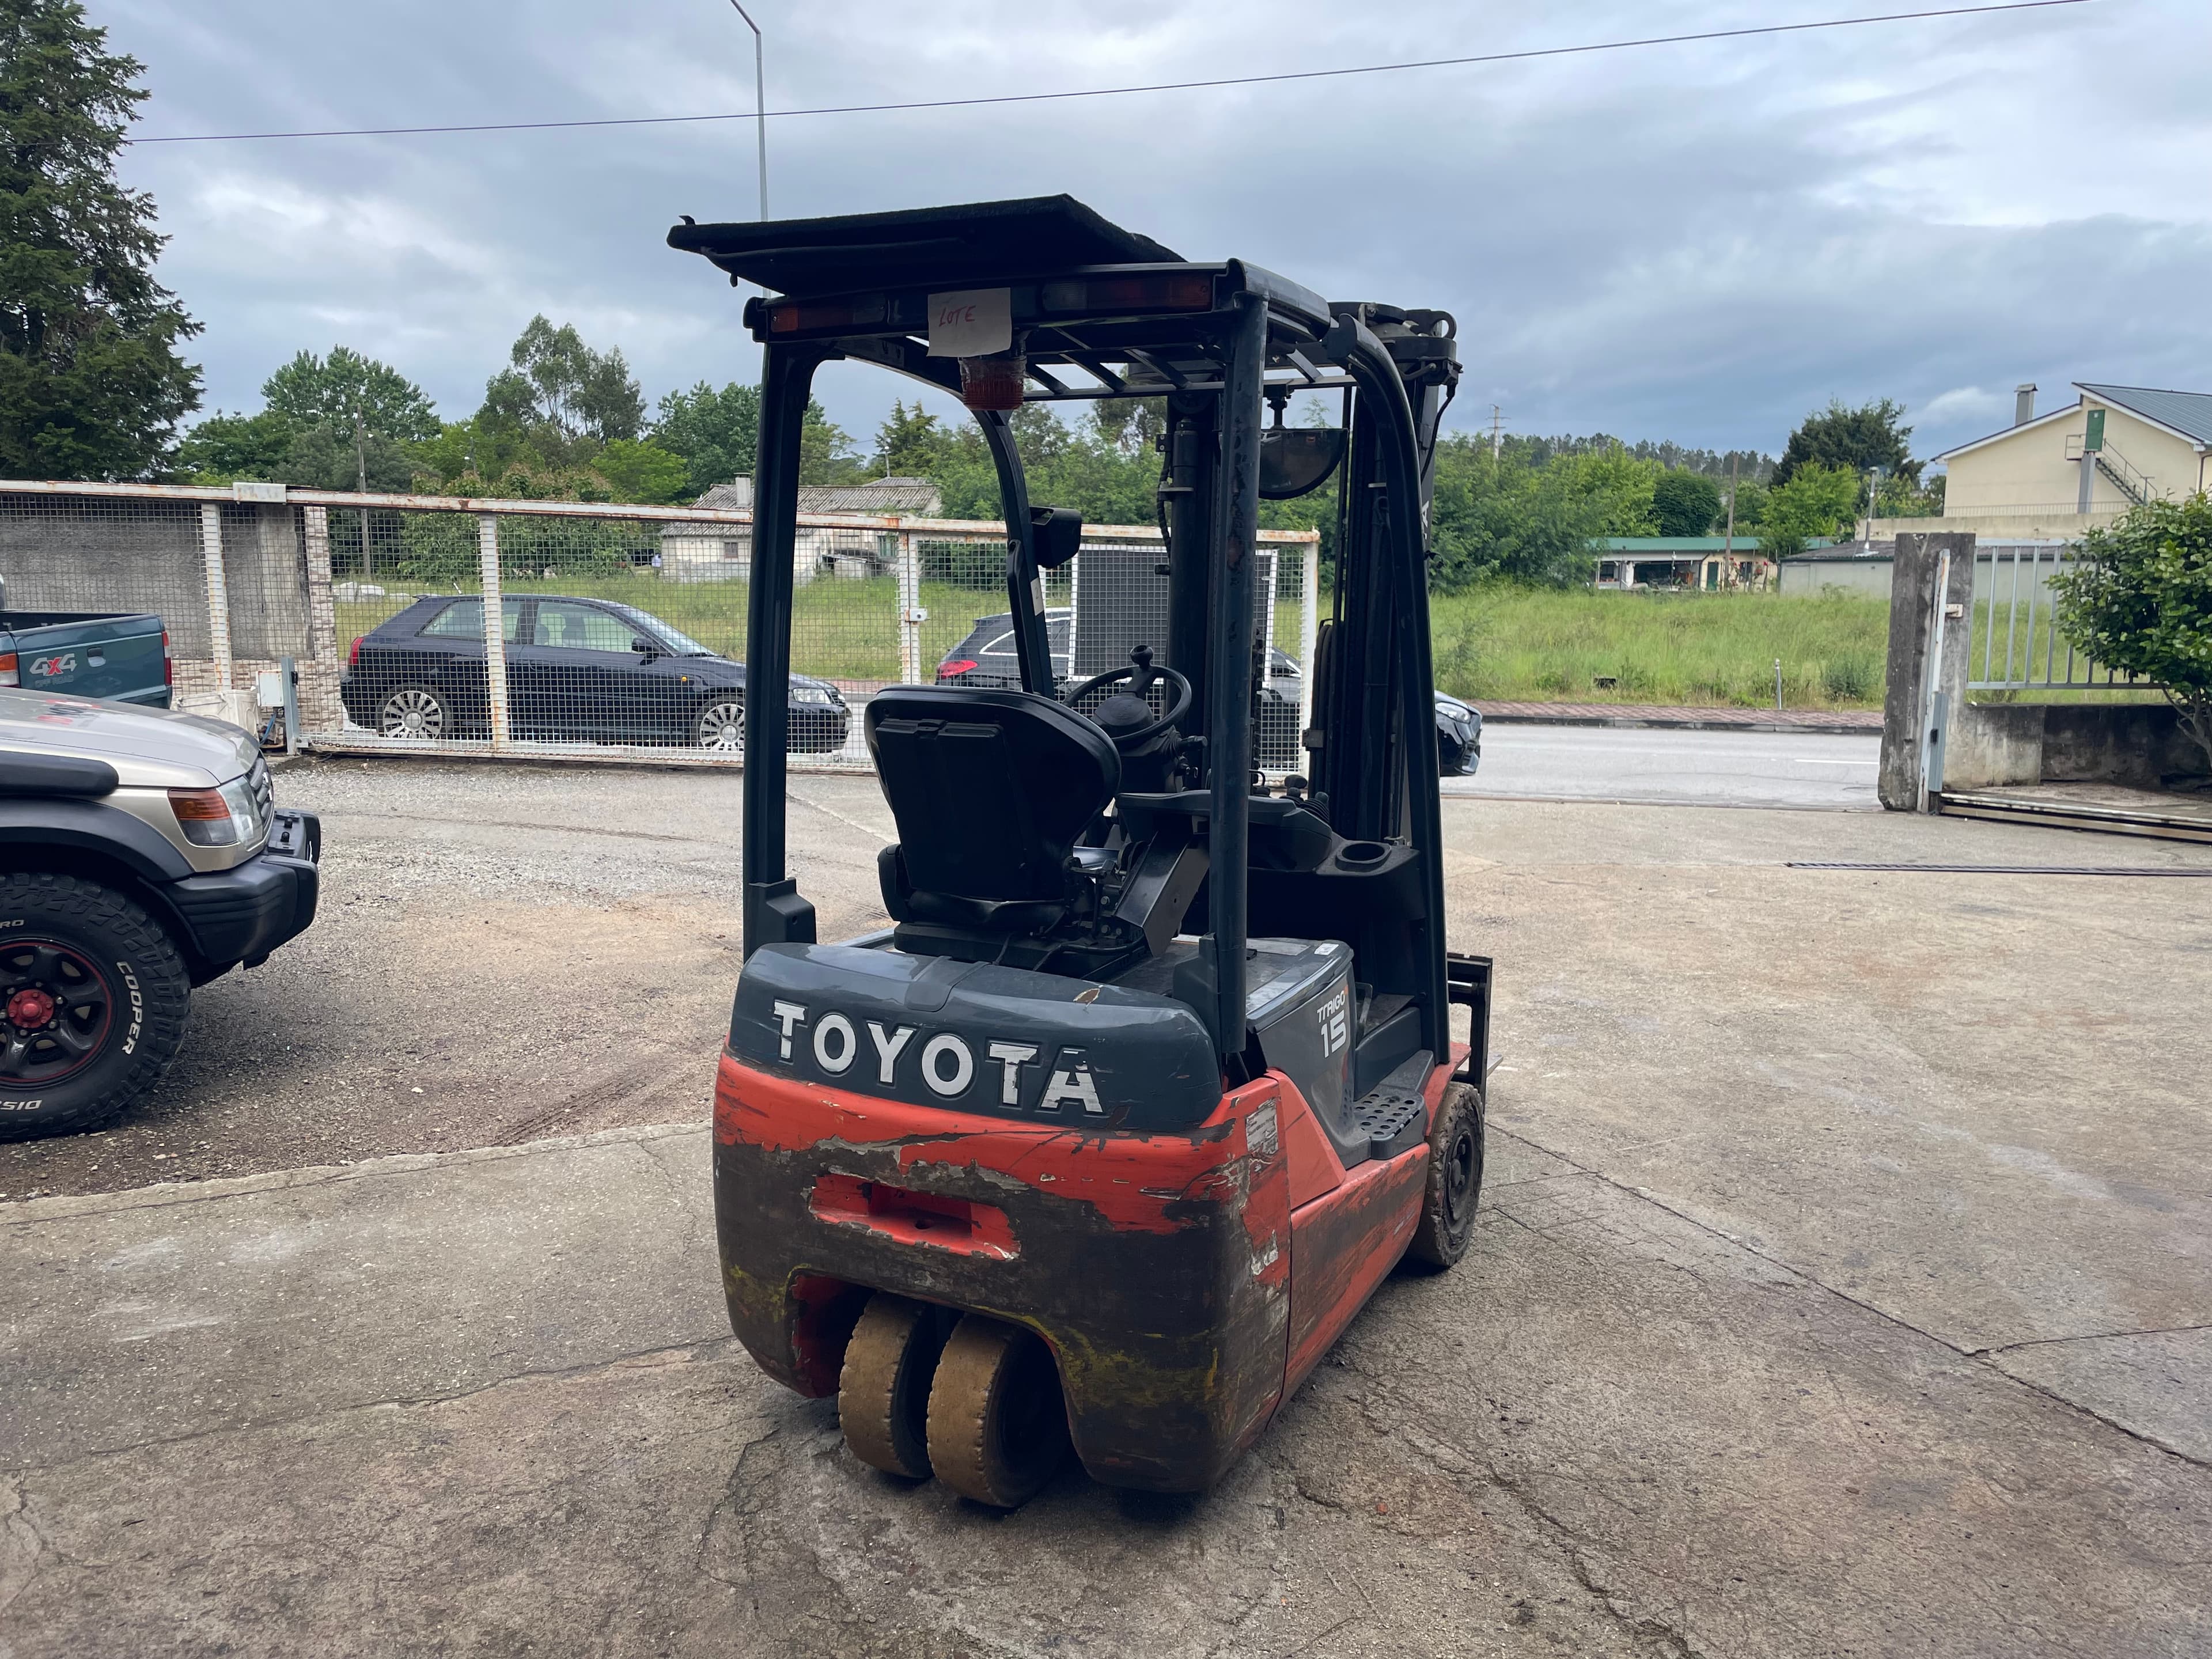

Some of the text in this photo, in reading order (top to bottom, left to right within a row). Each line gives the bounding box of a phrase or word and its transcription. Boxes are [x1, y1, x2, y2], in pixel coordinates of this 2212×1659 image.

[116, 961, 142, 1055] COOPER
[1321, 1009, 1346, 1059] 15
[774, 999, 1103, 1112] TOYOTA
[0, 1100, 42, 1111] DIS
